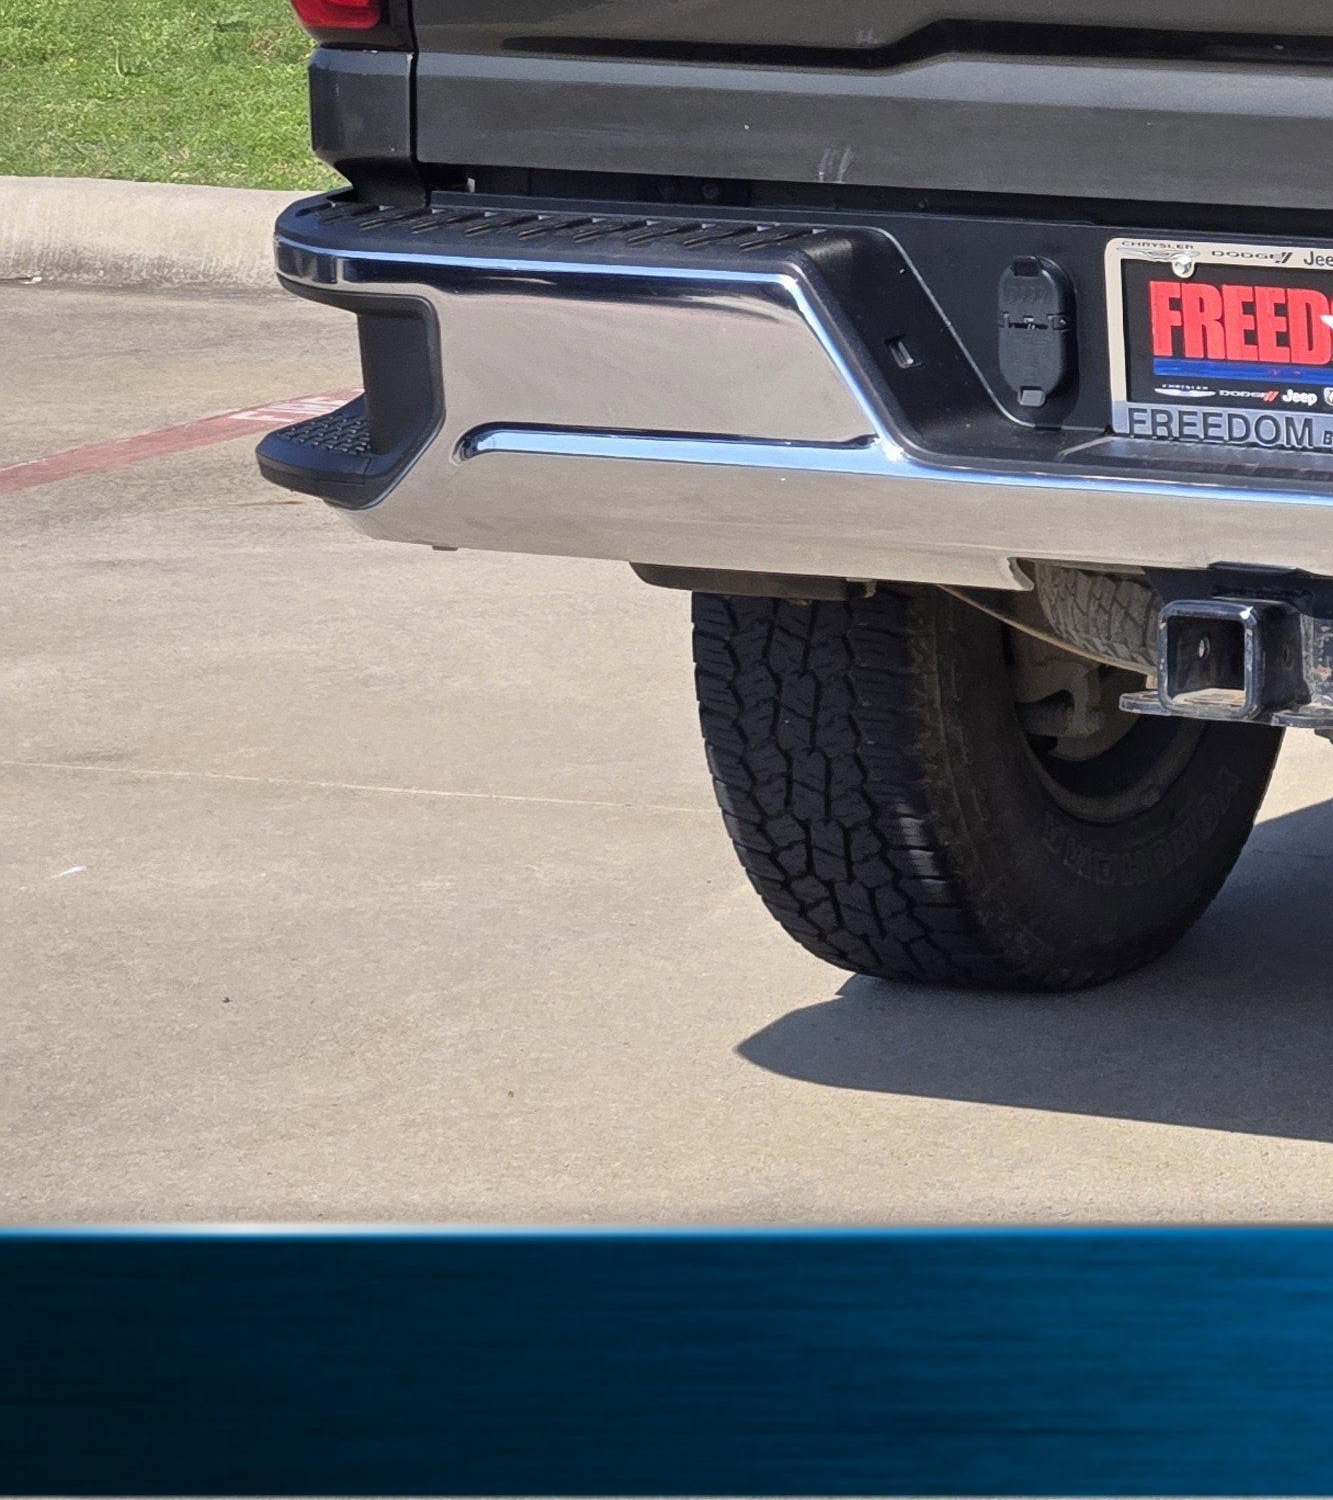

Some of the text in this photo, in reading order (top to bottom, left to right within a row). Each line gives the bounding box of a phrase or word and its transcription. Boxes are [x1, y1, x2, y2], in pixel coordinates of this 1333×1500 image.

[1121, 240, 1194, 250] CHRYSLER
[1282, 388, 1318, 406] Jeep
[1128, 407, 1314, 447] FREEDOM
